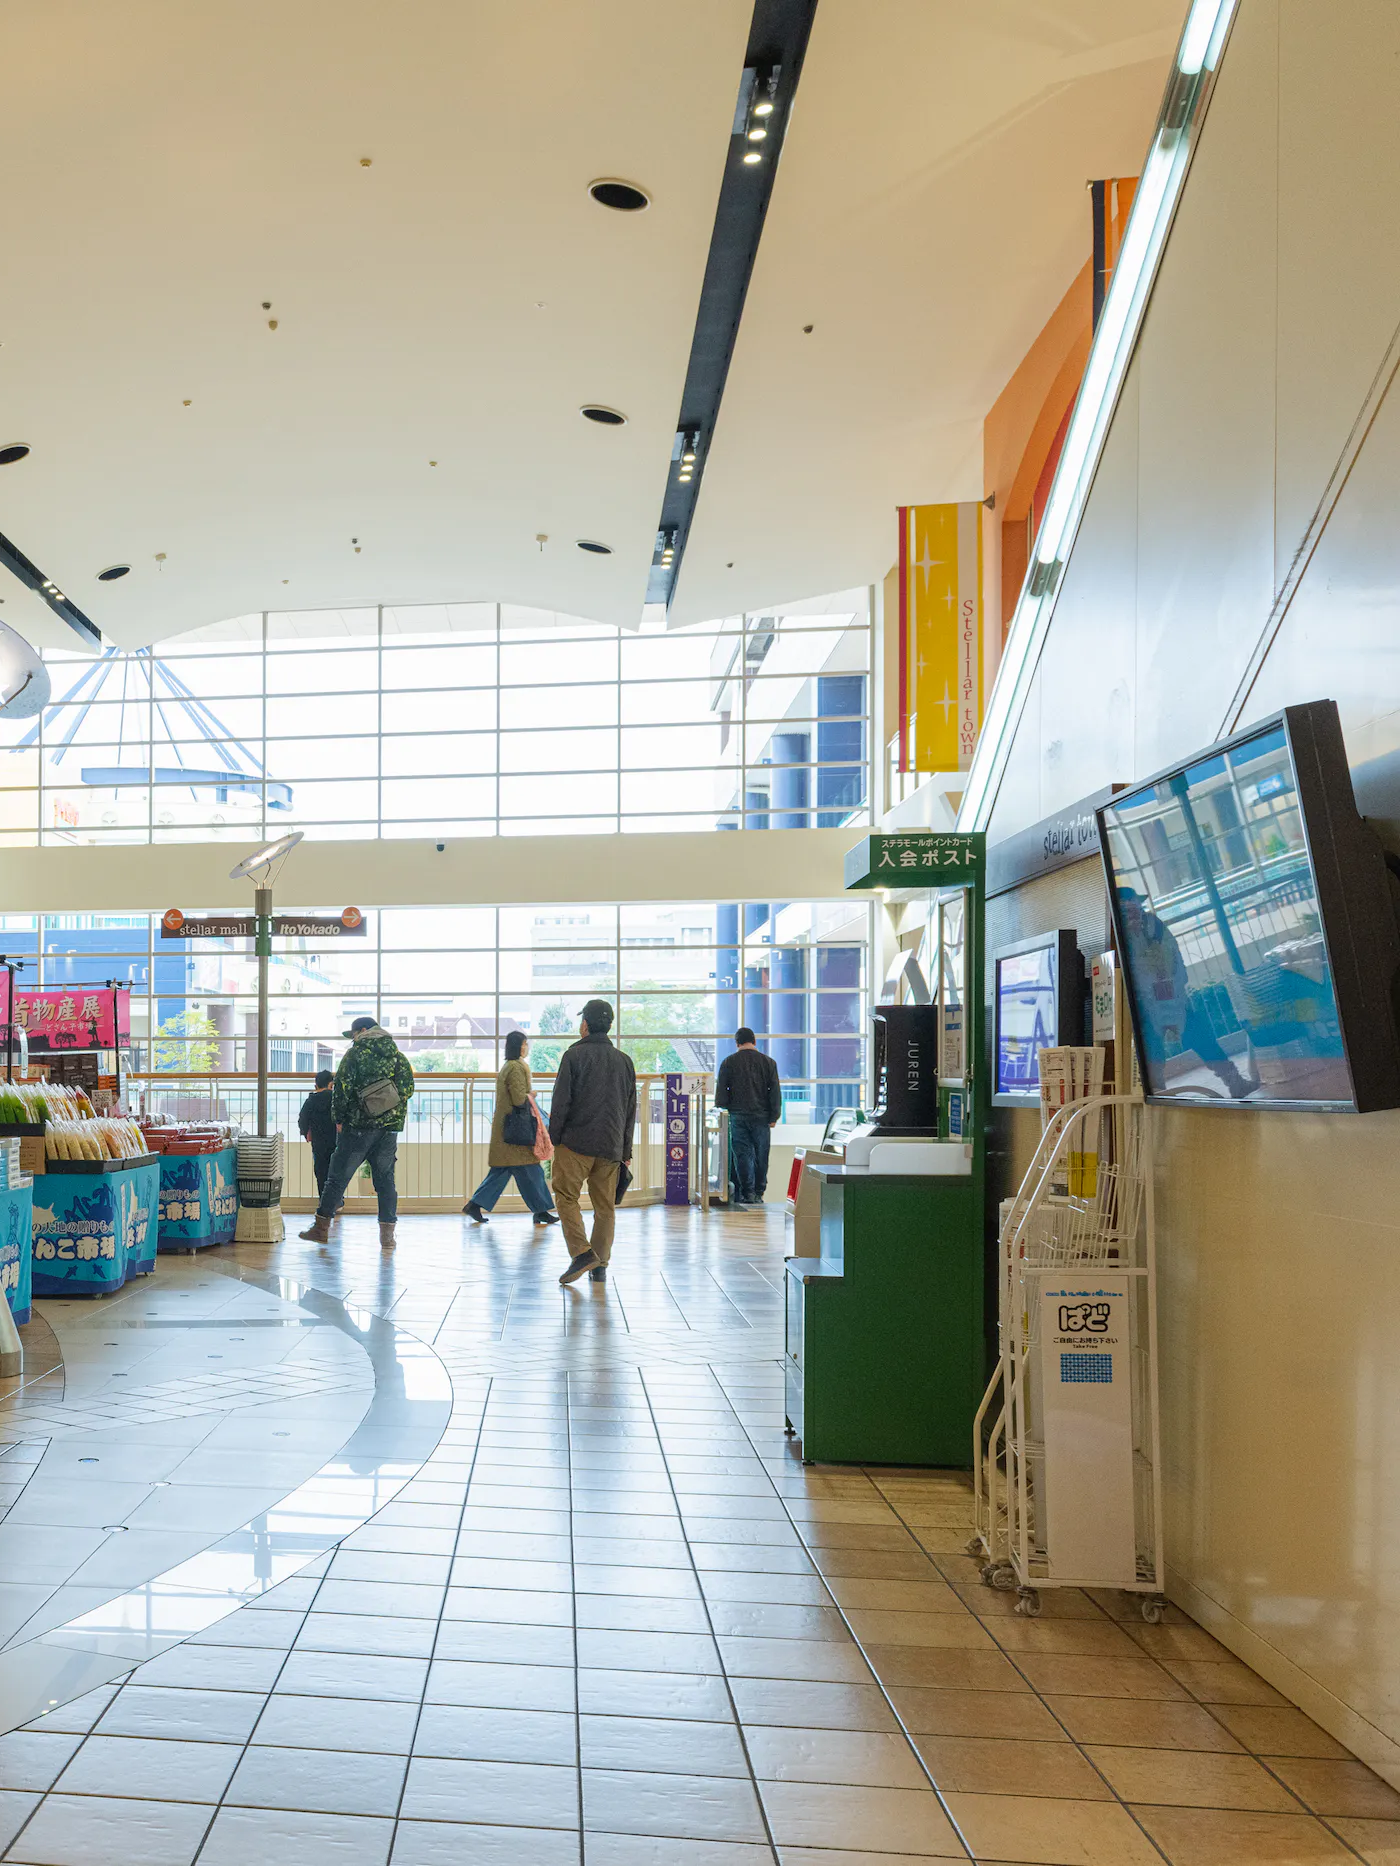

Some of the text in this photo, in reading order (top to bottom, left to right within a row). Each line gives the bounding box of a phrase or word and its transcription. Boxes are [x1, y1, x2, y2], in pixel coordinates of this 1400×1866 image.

[960, 599, 976, 755] Stellar town
[881, 837, 974, 848] ステラモールポイントカード
[878, 850, 977, 868] 入会ポスト
[179, 923, 247, 936] stellar mall
[907, 1040, 920, 1091] JUREN
[671, 1099, 686, 1113] 1F
[32, 1235, 116, 1261] んこ市場
[1058, 1303, 1111, 1333] ぱど
